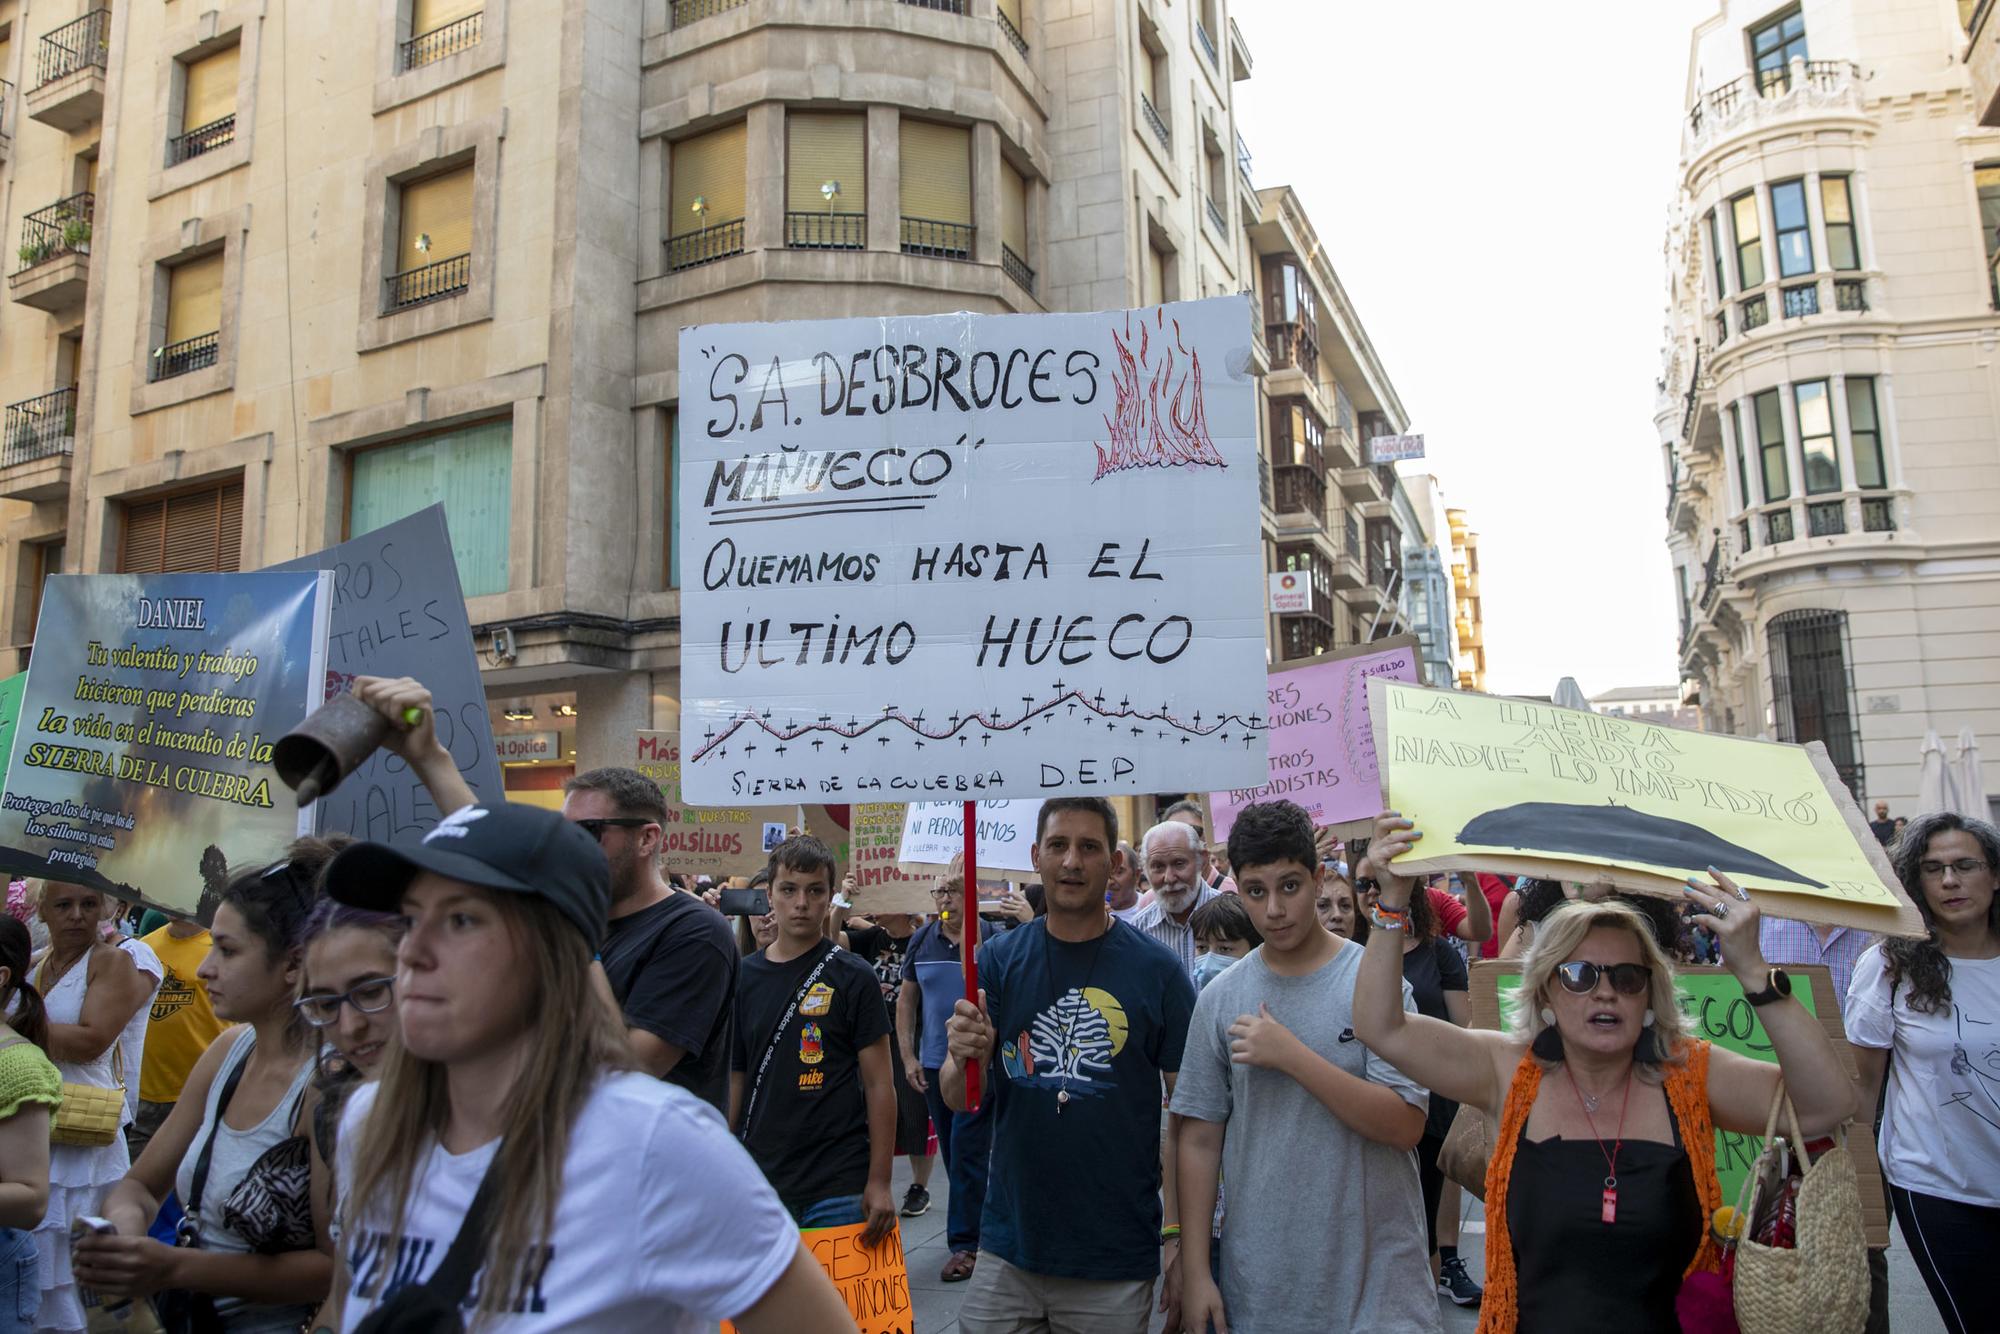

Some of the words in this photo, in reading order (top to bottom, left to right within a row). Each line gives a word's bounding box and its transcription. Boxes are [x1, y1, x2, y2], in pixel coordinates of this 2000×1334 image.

[811, 344, 1101, 417] DESBROCES
[703, 537, 880, 591] QUEMAMOS
[911, 542, 1048, 581] HASTA
[1088, 538, 1163, 580] EL
[137, 599, 206, 629] DANIEL
[976, 613, 1193, 667] HUECO
[87, 641, 109, 665] Tu
[110, 644, 178, 669] valentía
[180, 653, 196, 678] y
[197, 650, 258, 682] trabajo
[1370, 660, 1405, 676] SUELDO
[75, 676, 143, 705] hicieron
[148, 689, 176, 714] que
[177, 686, 256, 718] perdieras
[38, 708, 67, 733] la
[73, 713, 111, 740] vida
[115, 725, 135, 745] en
[137, 721, 154, 744] el
[156, 727, 224, 757] incendio
[226, 740, 249, 760] de
[249, 734, 275, 763] la
[1393, 689, 1462, 721] LA
[1500, 702, 1682, 753] LLEIRA
[509, 740, 547, 758] Optica
[25, 743, 115, 777] SIERRA
[117, 756, 144, 781] DE
[143, 760, 170, 789] LA
[175, 767, 274, 808] CULEBRA
[732, 771, 806, 795] SIERRA
[820, 776, 843, 793] DE
[1040, 756, 1137, 788] D.E.P.
[1229, 768, 1340, 806] BRIGADISTAS
[1395, 735, 1528, 774] NADIE
[1550, 753, 1598, 785] LO
[1610, 766, 1818, 826] IMPIDIÓ
[3, 793, 50, 816] Protege
[51, 804, 61, 817] a
[62, 800, 79, 817] los
[80, 803, 90, 820] de
[698, 809, 753, 824] VUESTROS
[25, 818, 46, 835] los
[47, 823, 88, 843] sillones
[911, 820, 922, 836] NI
[928, 817, 1016, 842] PERDOAMOS
[803, 961, 826, 989] adidas
[777, 1001, 797, 1032] adidas
